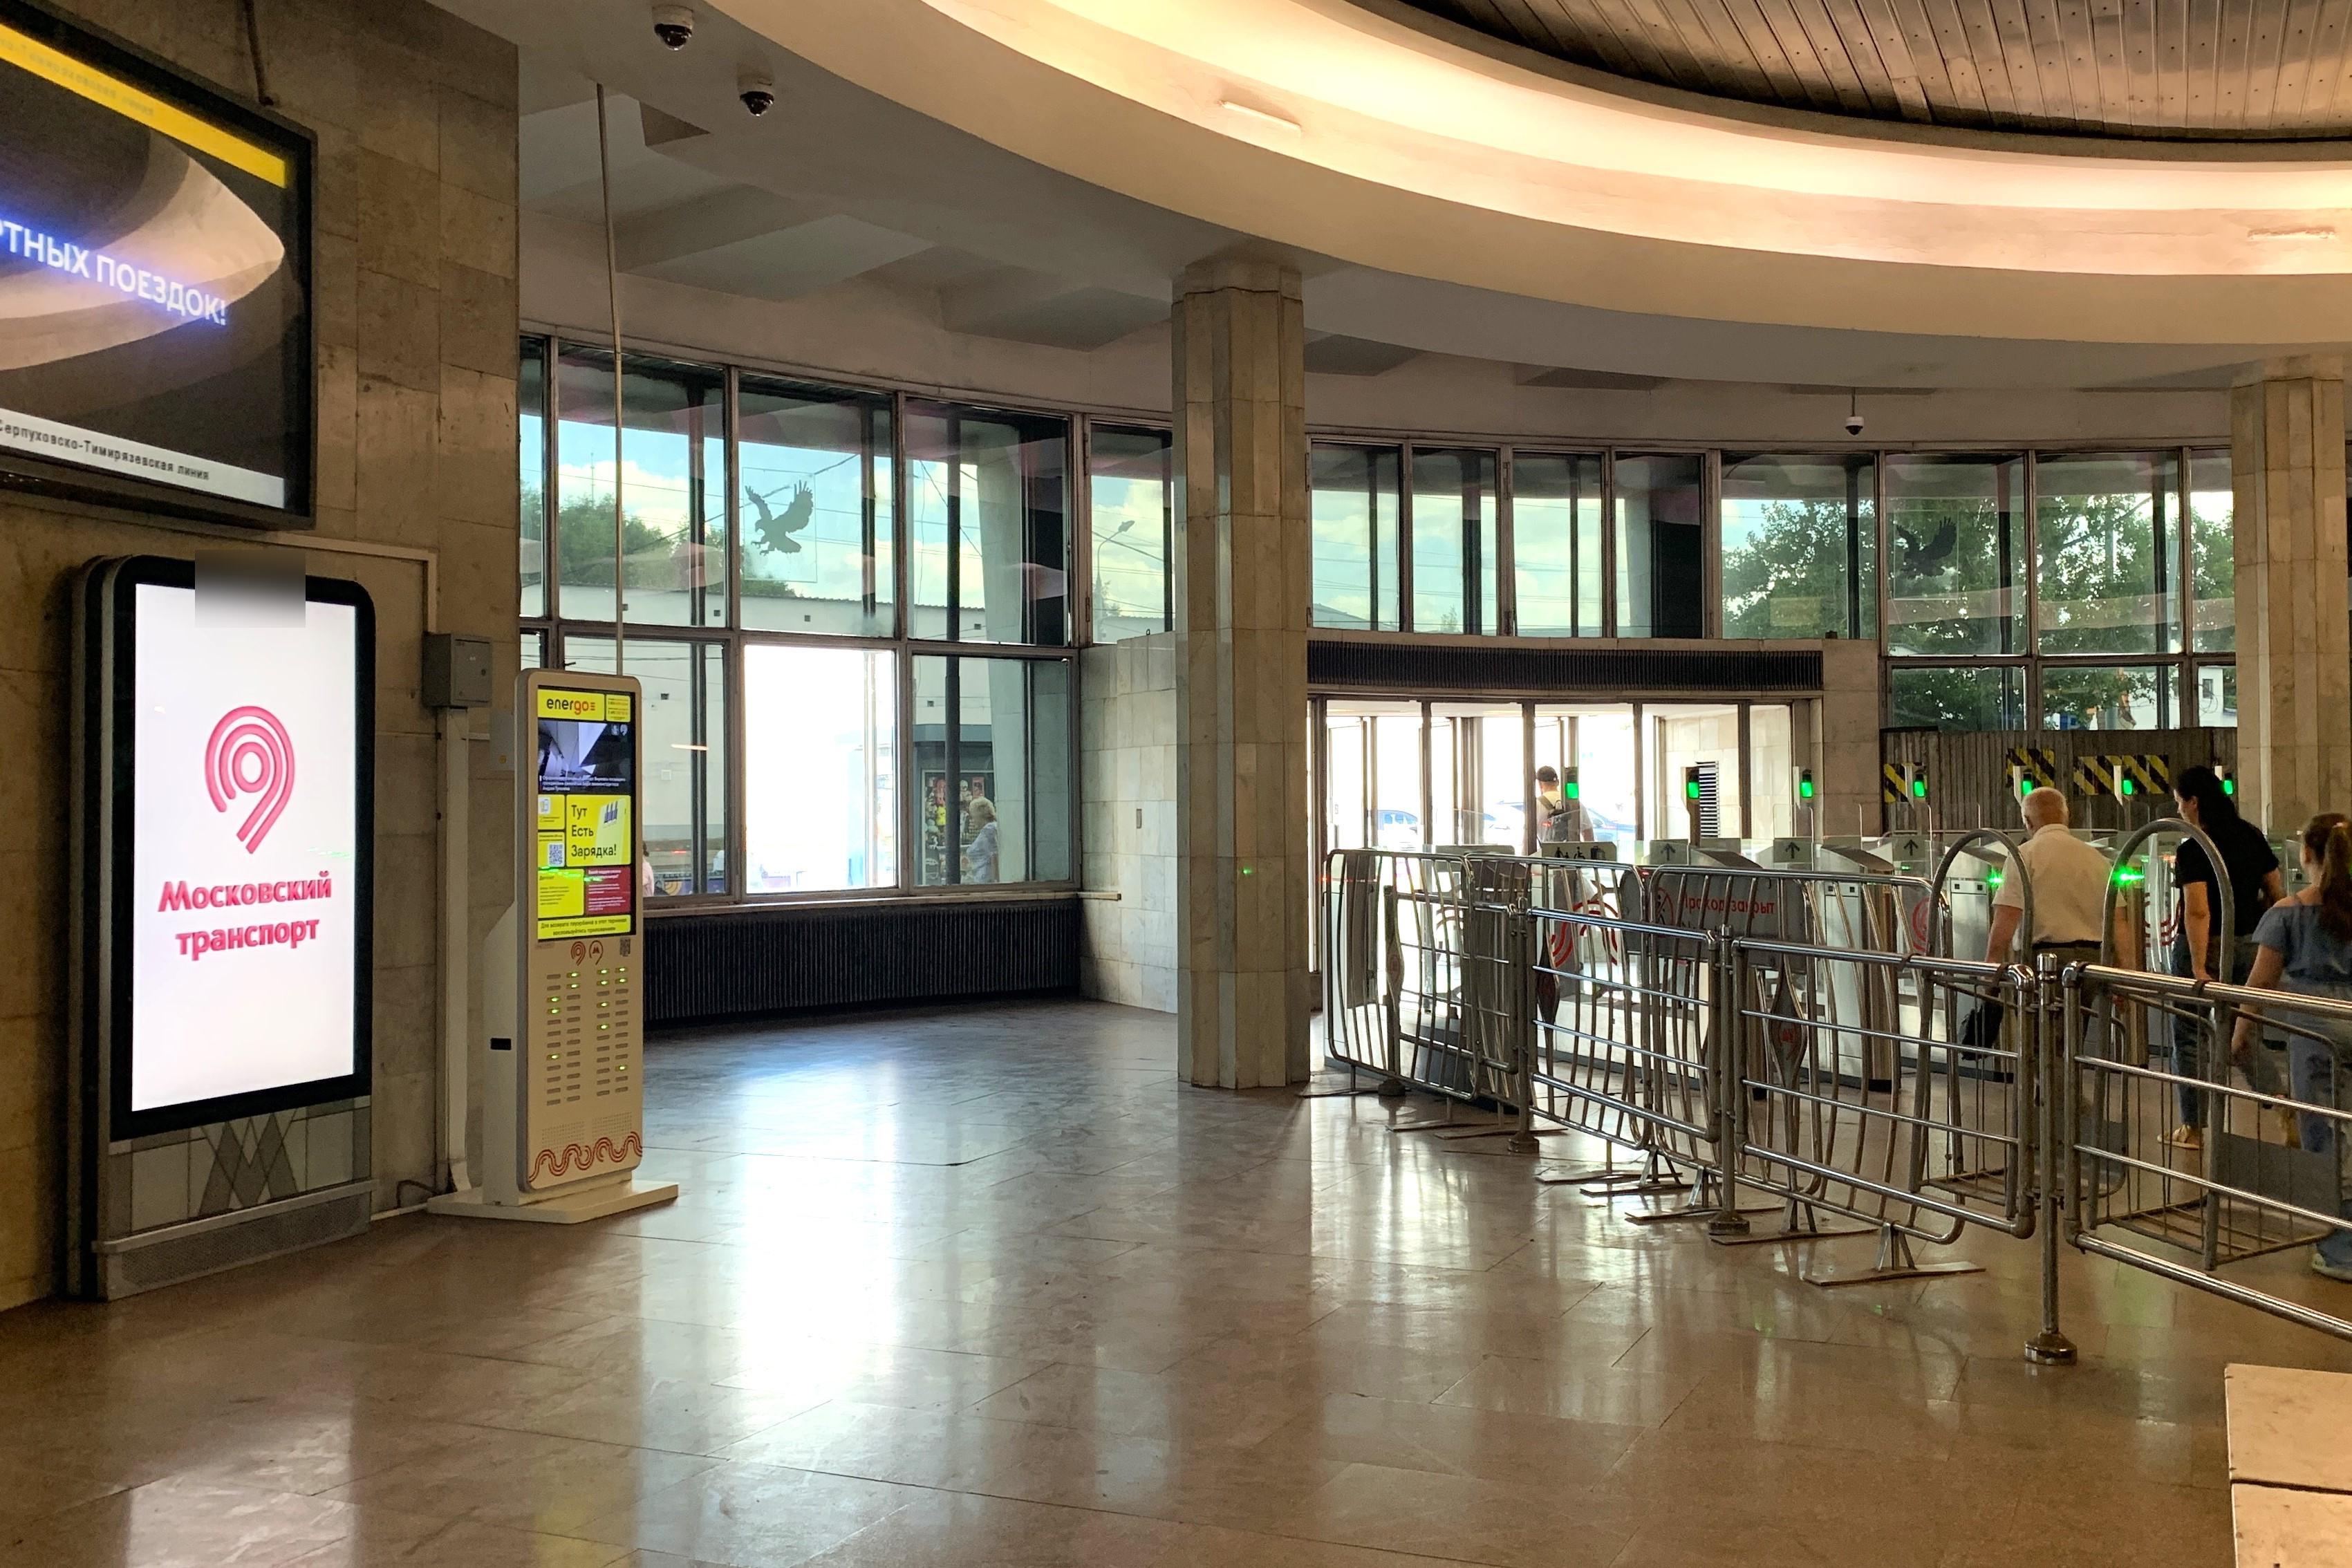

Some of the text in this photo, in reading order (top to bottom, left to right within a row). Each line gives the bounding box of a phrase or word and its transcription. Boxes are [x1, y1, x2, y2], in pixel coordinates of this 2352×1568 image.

[97, 254, 226, 326] ПОЕЗДОК!
[178, 465, 209, 480] линия
[571, 804, 588, 820] Тут
[571, 825, 594, 837] Есть
[571, 843, 617, 859] Зарядка!
[158, 870, 332, 913] Московский
[176, 919, 319, 961] транспорт
